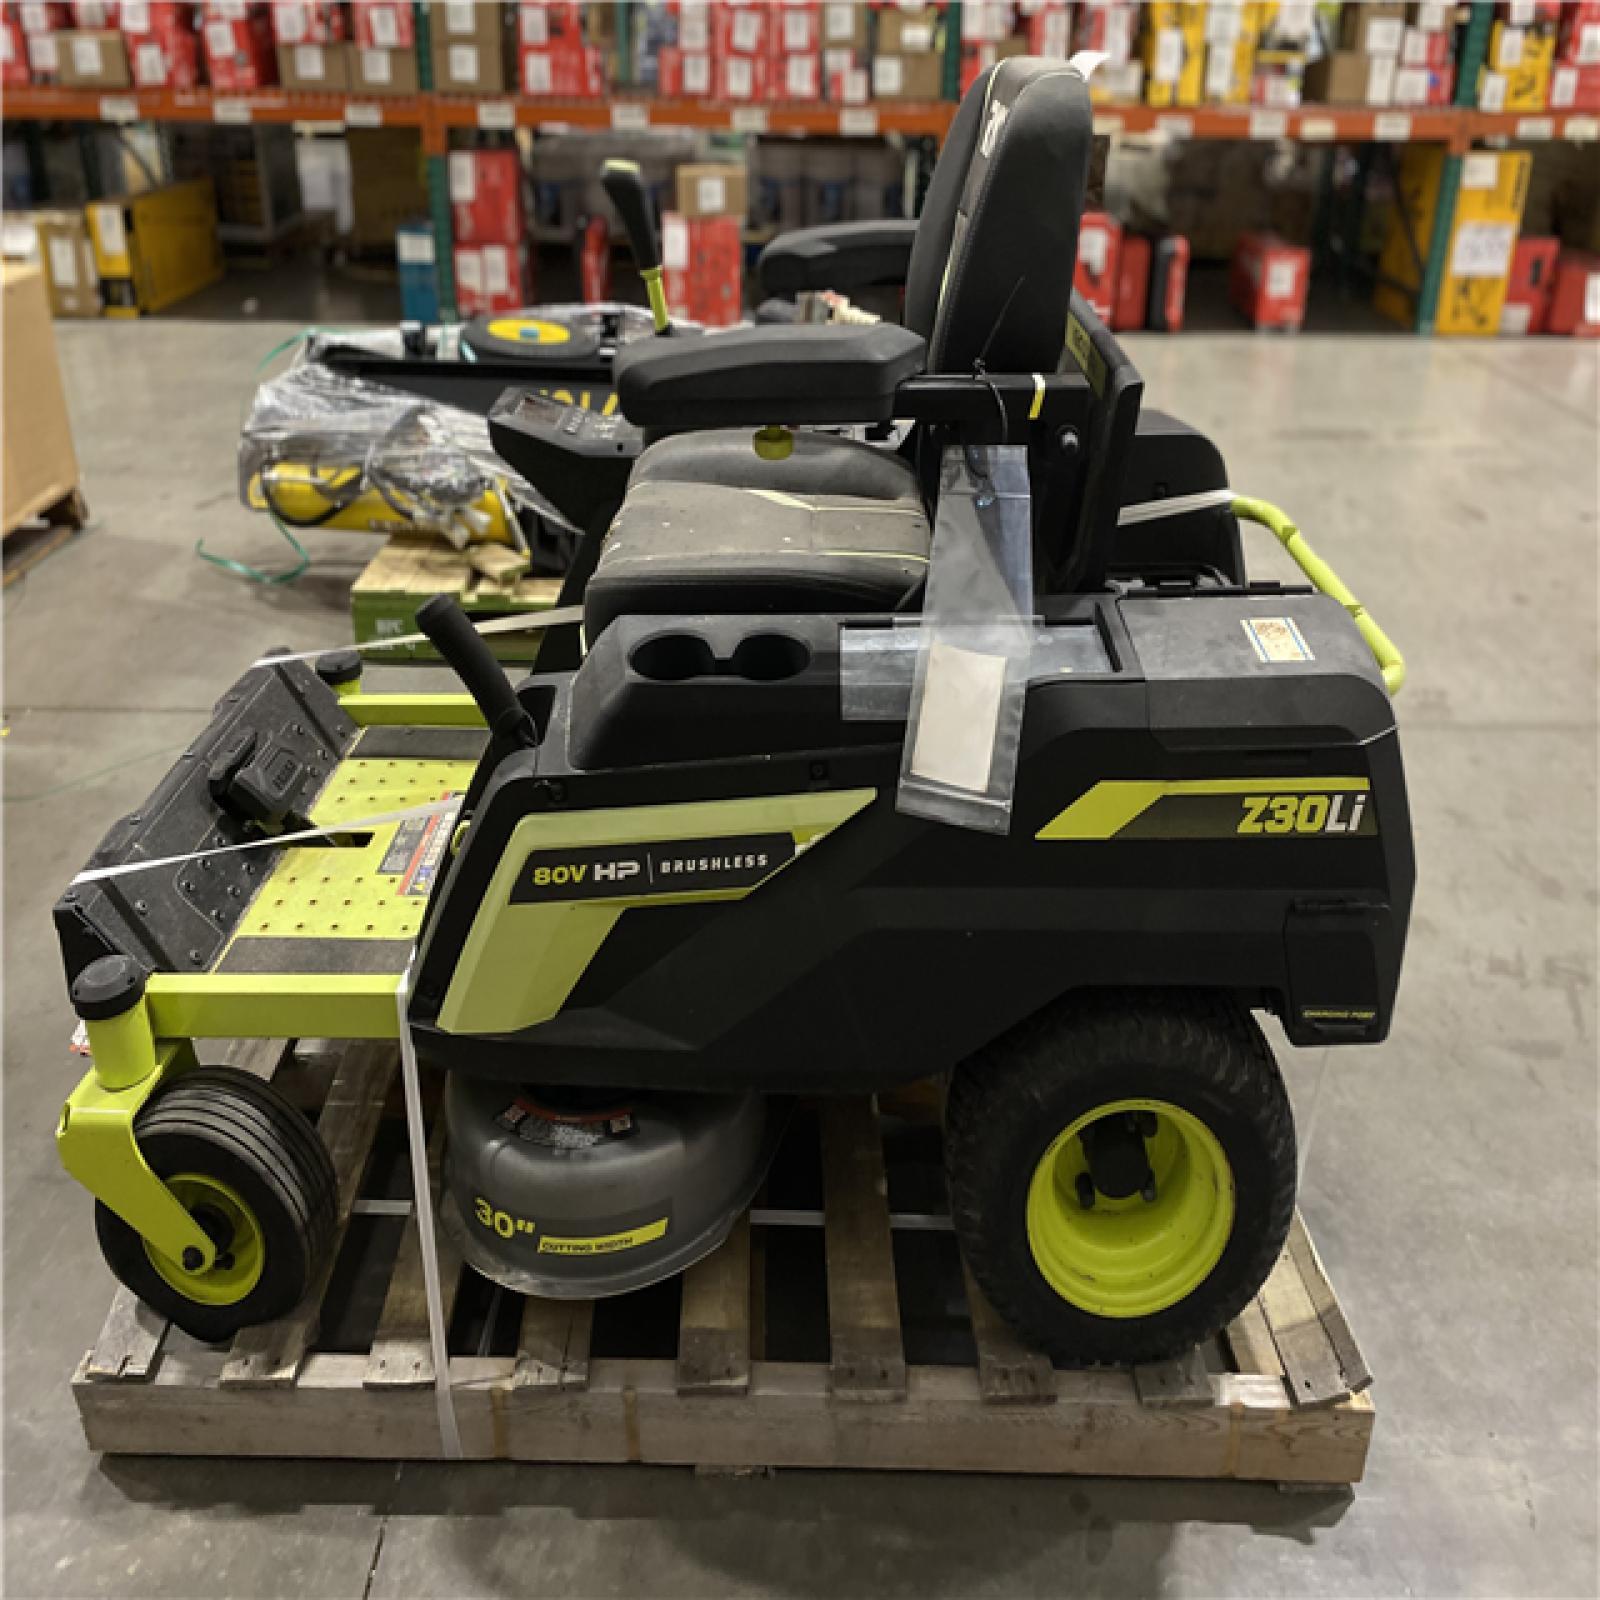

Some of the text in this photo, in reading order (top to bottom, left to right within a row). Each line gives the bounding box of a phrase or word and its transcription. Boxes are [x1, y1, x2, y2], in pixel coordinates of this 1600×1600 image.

[1237, 794, 1366, 833] Z30Li
[533, 854, 769, 886] 80V HP BRUSHLESS
